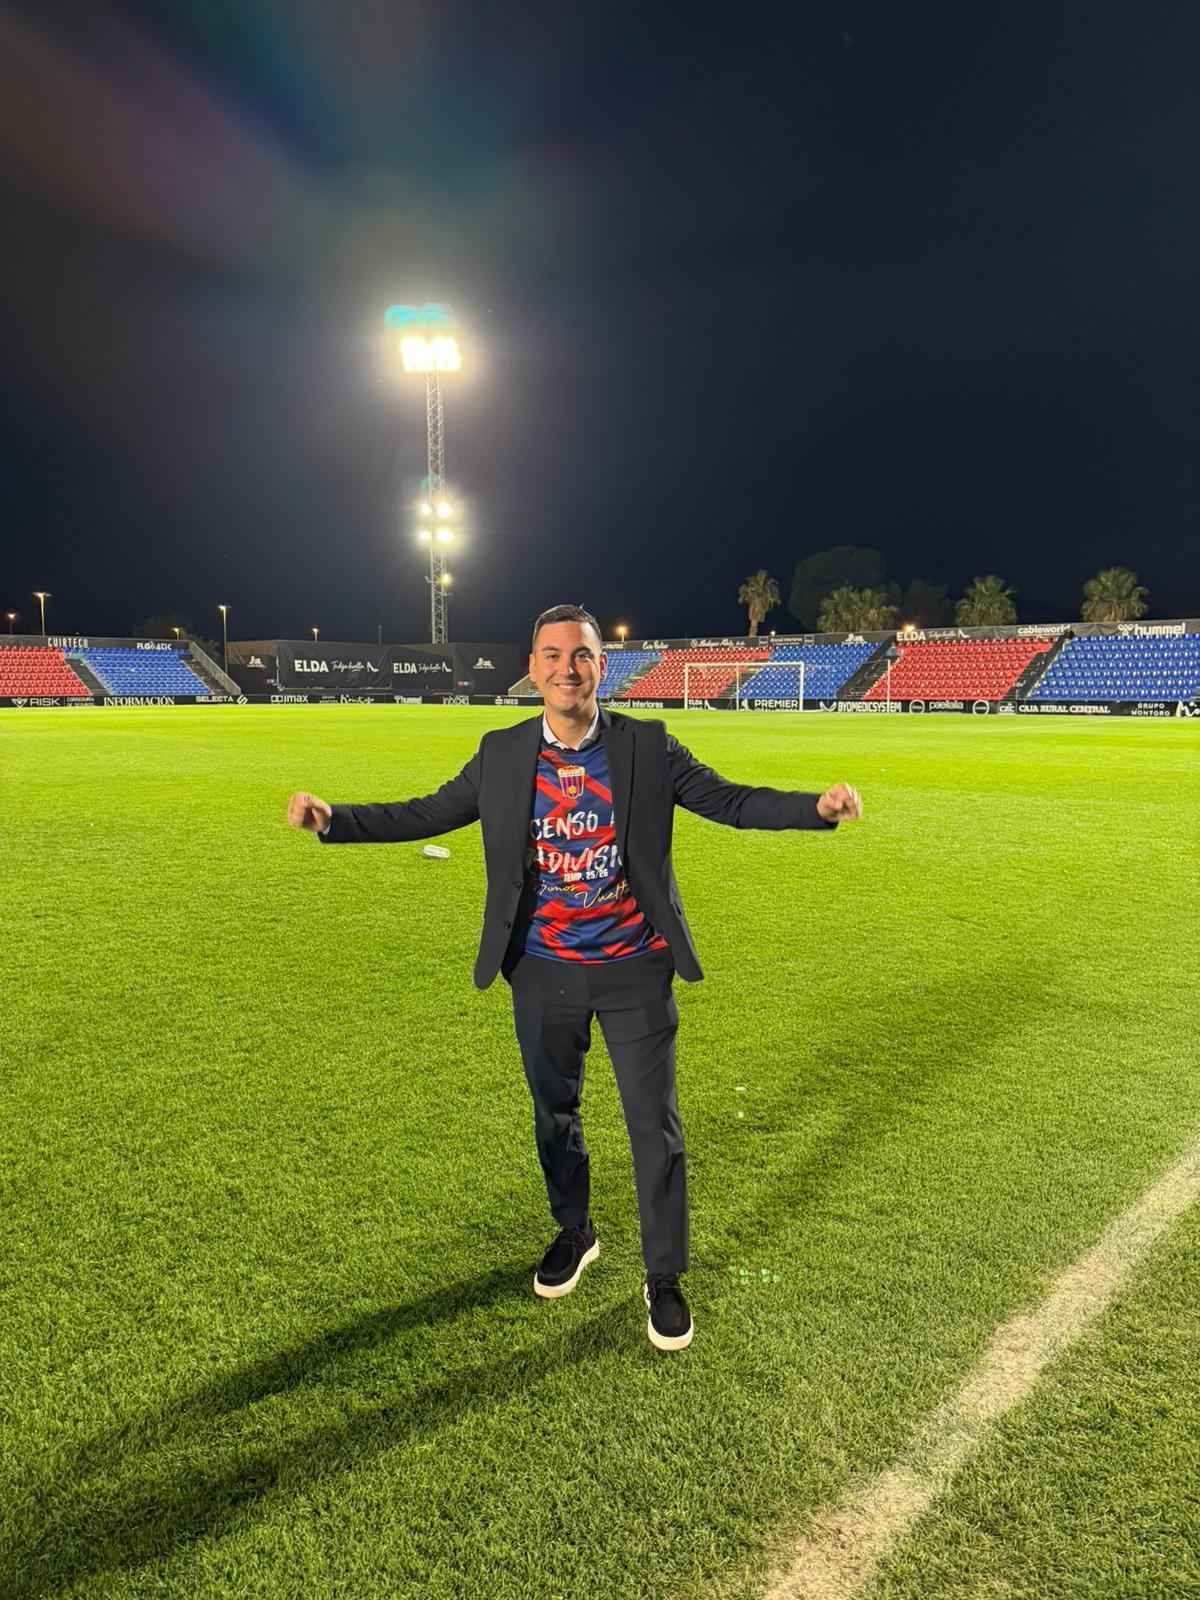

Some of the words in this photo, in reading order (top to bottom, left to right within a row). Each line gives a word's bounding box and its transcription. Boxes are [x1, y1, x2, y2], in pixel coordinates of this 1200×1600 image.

[1134, 623, 1186, 635] hummel
[896, 631, 926, 642] ELDA
[294, 659, 329, 673] ELDA
[393, 662, 418, 674] ELDA
[29, 697, 60, 706] RISK
[103, 695, 175, 707] INFORMACIÓN
[754, 699, 799, 708] PREMIER
[1069, 704, 1111, 714] CENTRAL
[530, 810, 599, 841] CENSO
[585, 868, 609, 881] 25/26
